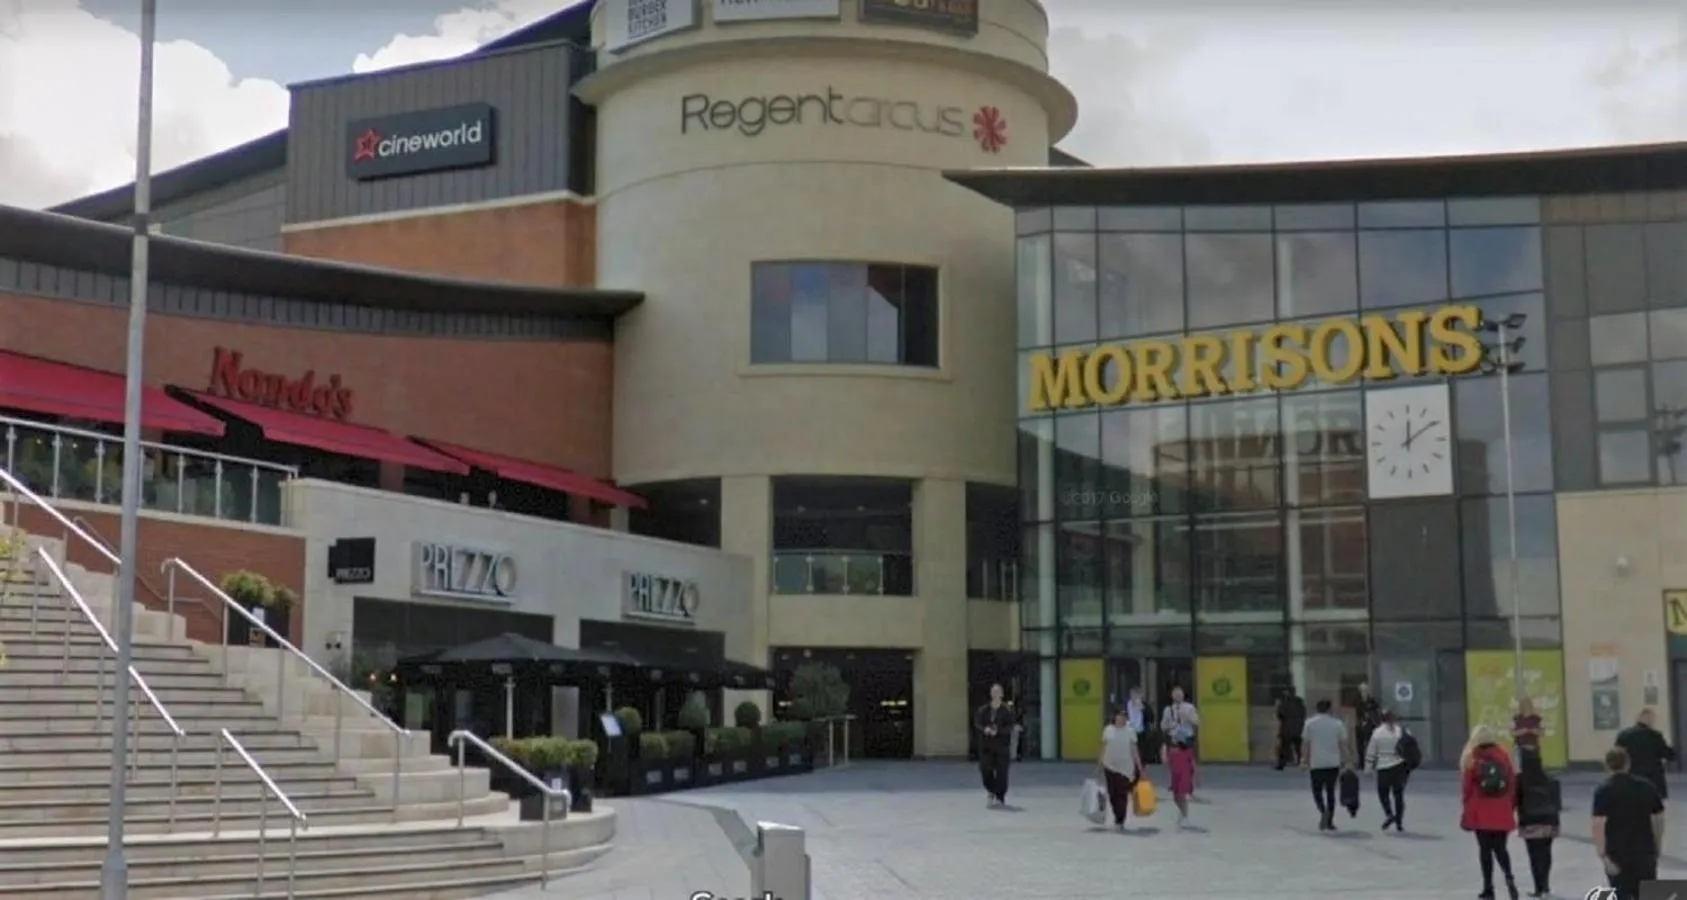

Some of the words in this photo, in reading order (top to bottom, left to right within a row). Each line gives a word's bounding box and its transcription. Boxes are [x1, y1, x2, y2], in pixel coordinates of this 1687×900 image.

[378, 119, 482, 157] cineworld
[207, 346, 356, 421] Nando's
[1028, 304, 1484, 413] MORRISONS
[418, 542, 517, 597] PREZZO
[627, 571, 700, 617] PREZZO
